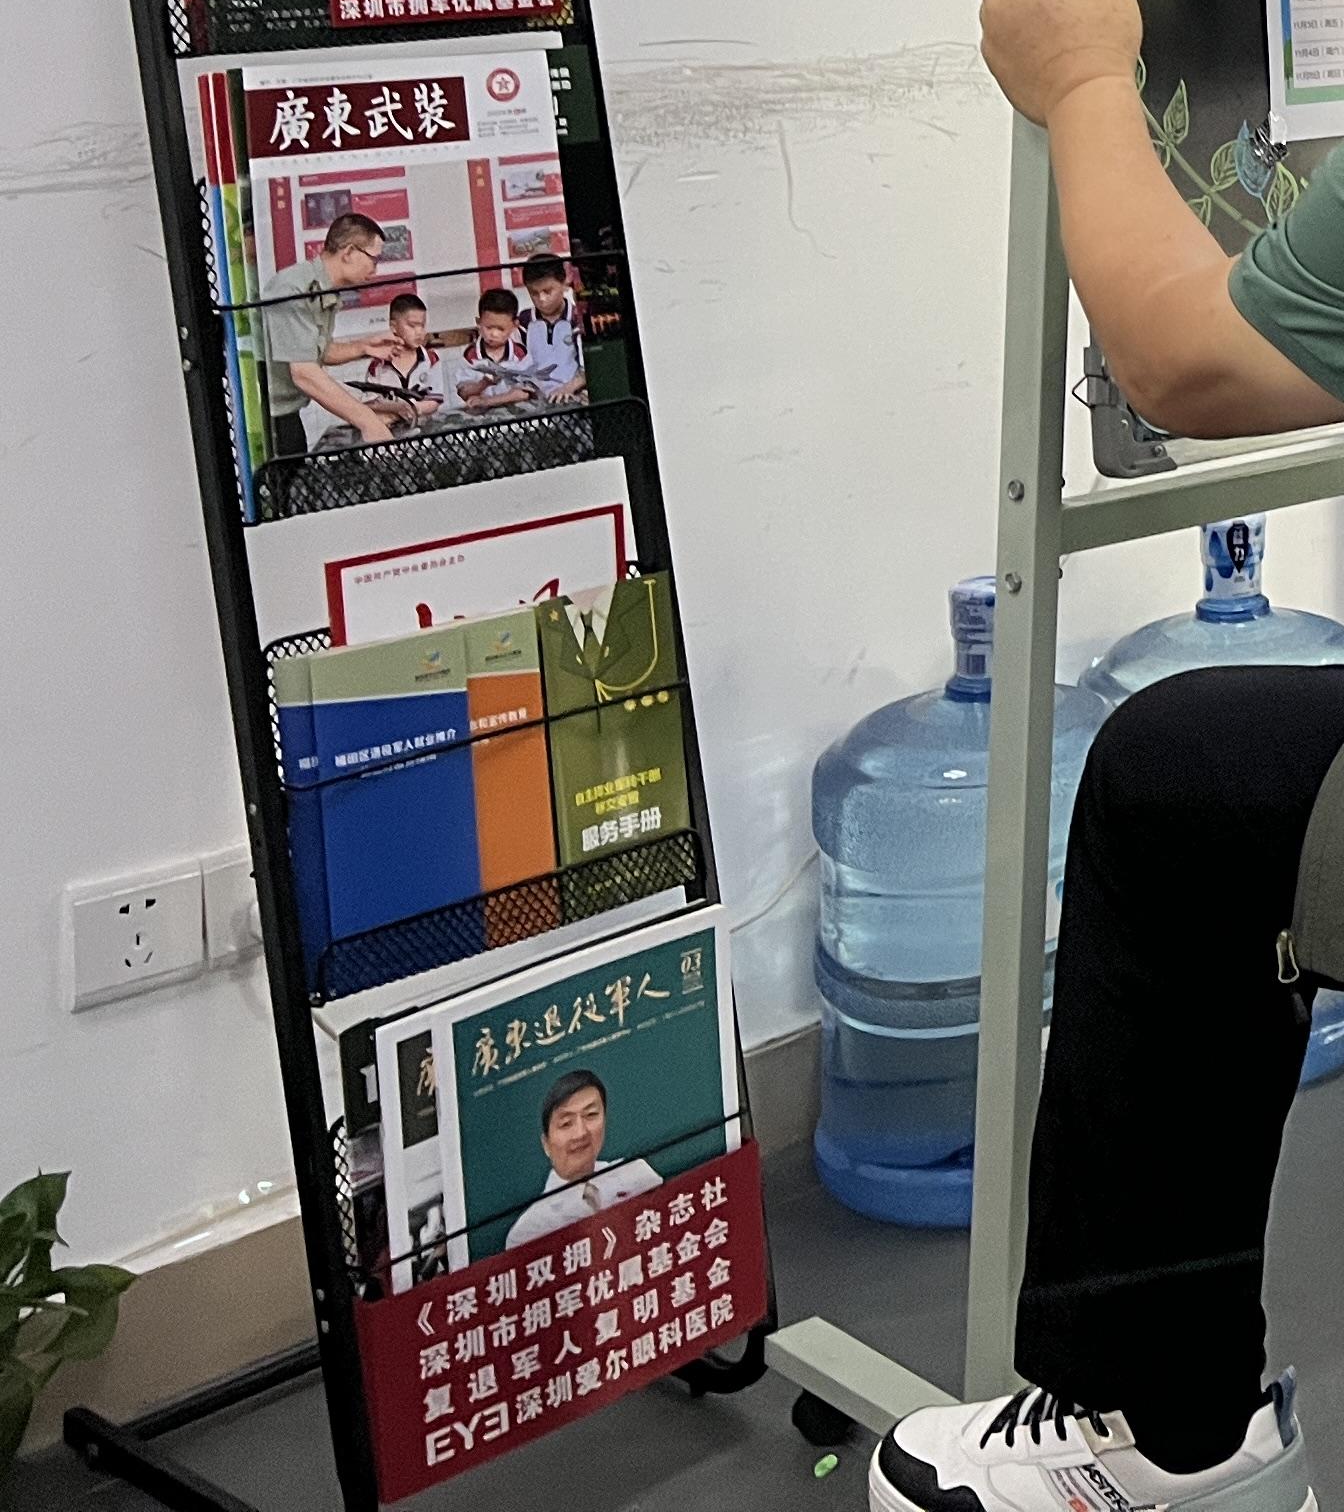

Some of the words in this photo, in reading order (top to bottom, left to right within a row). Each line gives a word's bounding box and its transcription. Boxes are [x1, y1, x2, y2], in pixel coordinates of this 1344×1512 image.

[269, 82, 456, 151] 廣東武裝
[581, 806, 663, 852] 服务手册
[415, 1176, 729, 1337] 《深圳双拥》杂志社
[419, 1217, 730, 1381] 深圳市拥军优属基金会
[422, 1255, 732, 1424] 复退军人复明基金
[515, 1293, 735, 1425] 深圳爱尔眼科医院
